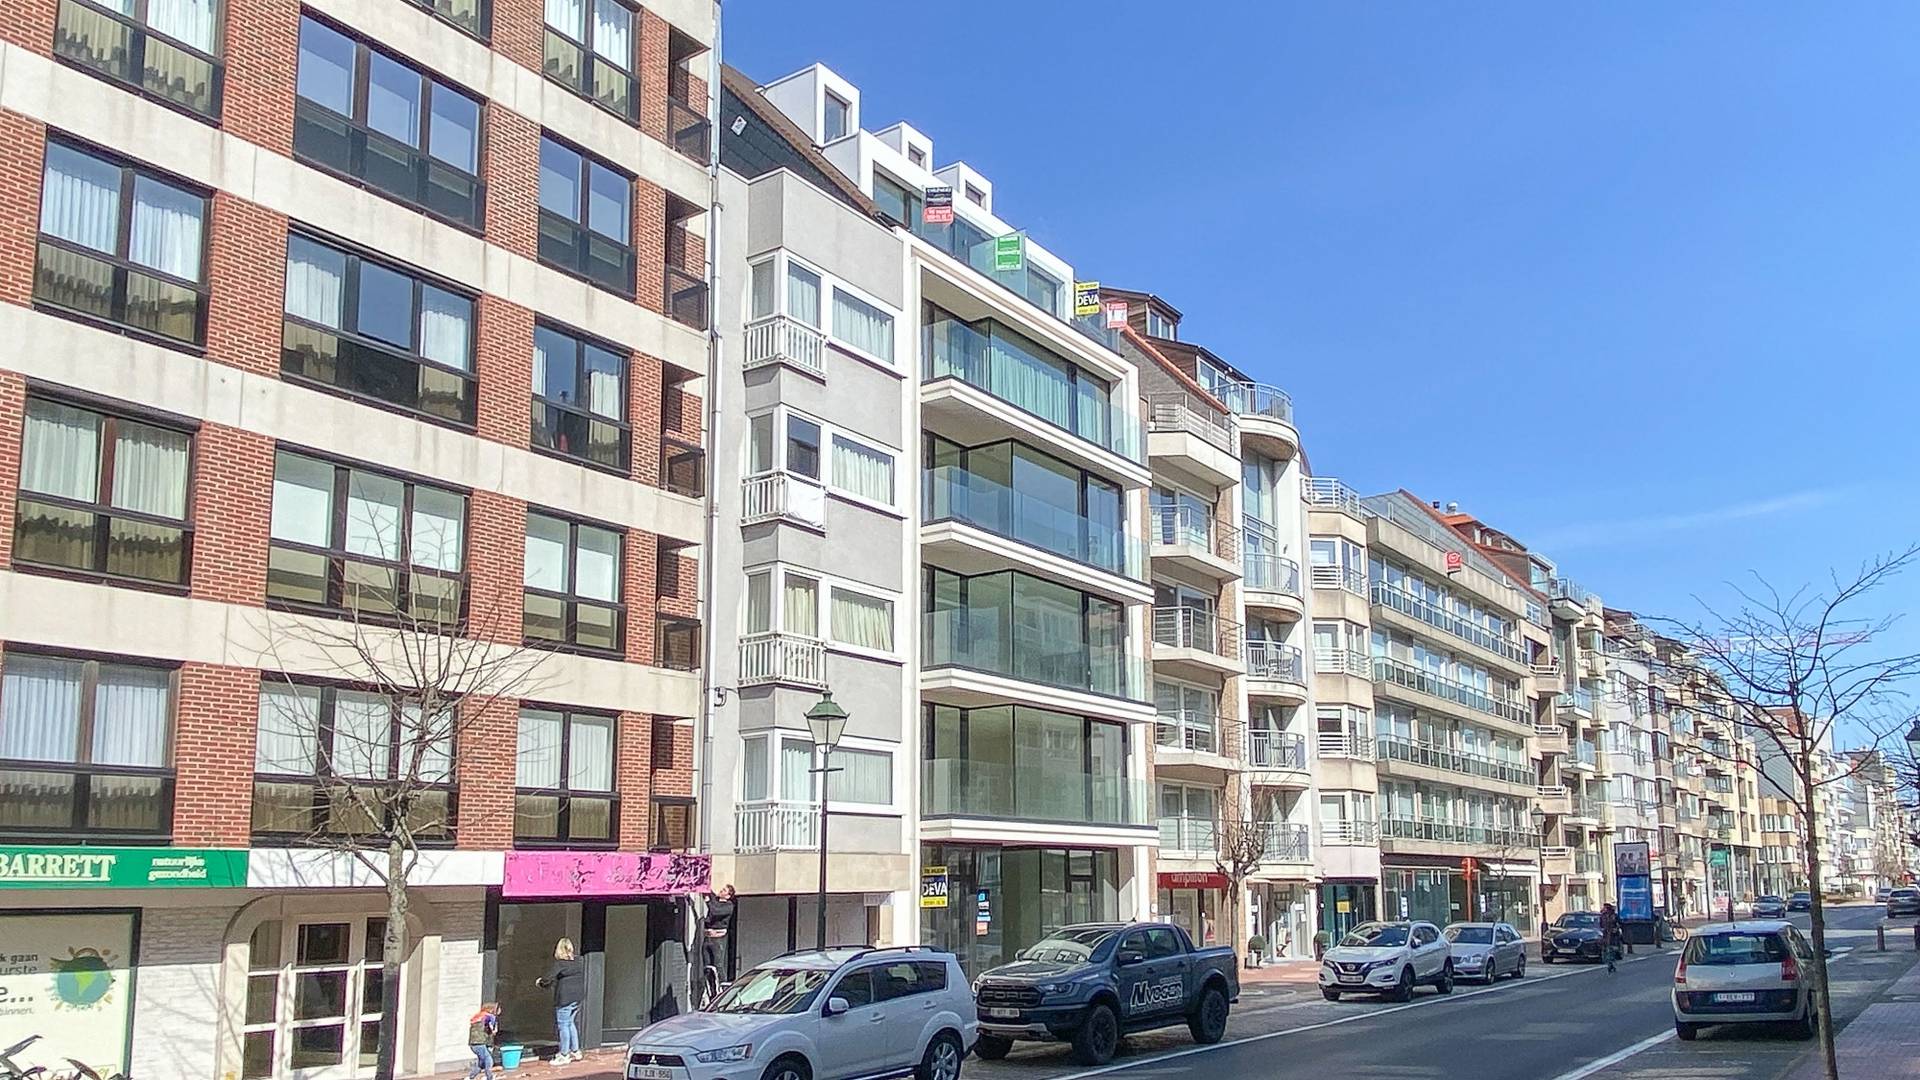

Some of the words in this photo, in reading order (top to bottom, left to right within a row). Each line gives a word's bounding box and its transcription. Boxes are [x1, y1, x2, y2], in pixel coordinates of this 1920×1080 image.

[1078, 294, 1099, 305] DEVA
[0, 854, 116, 881] BARRETT
[922, 882, 947, 896] DEVA
